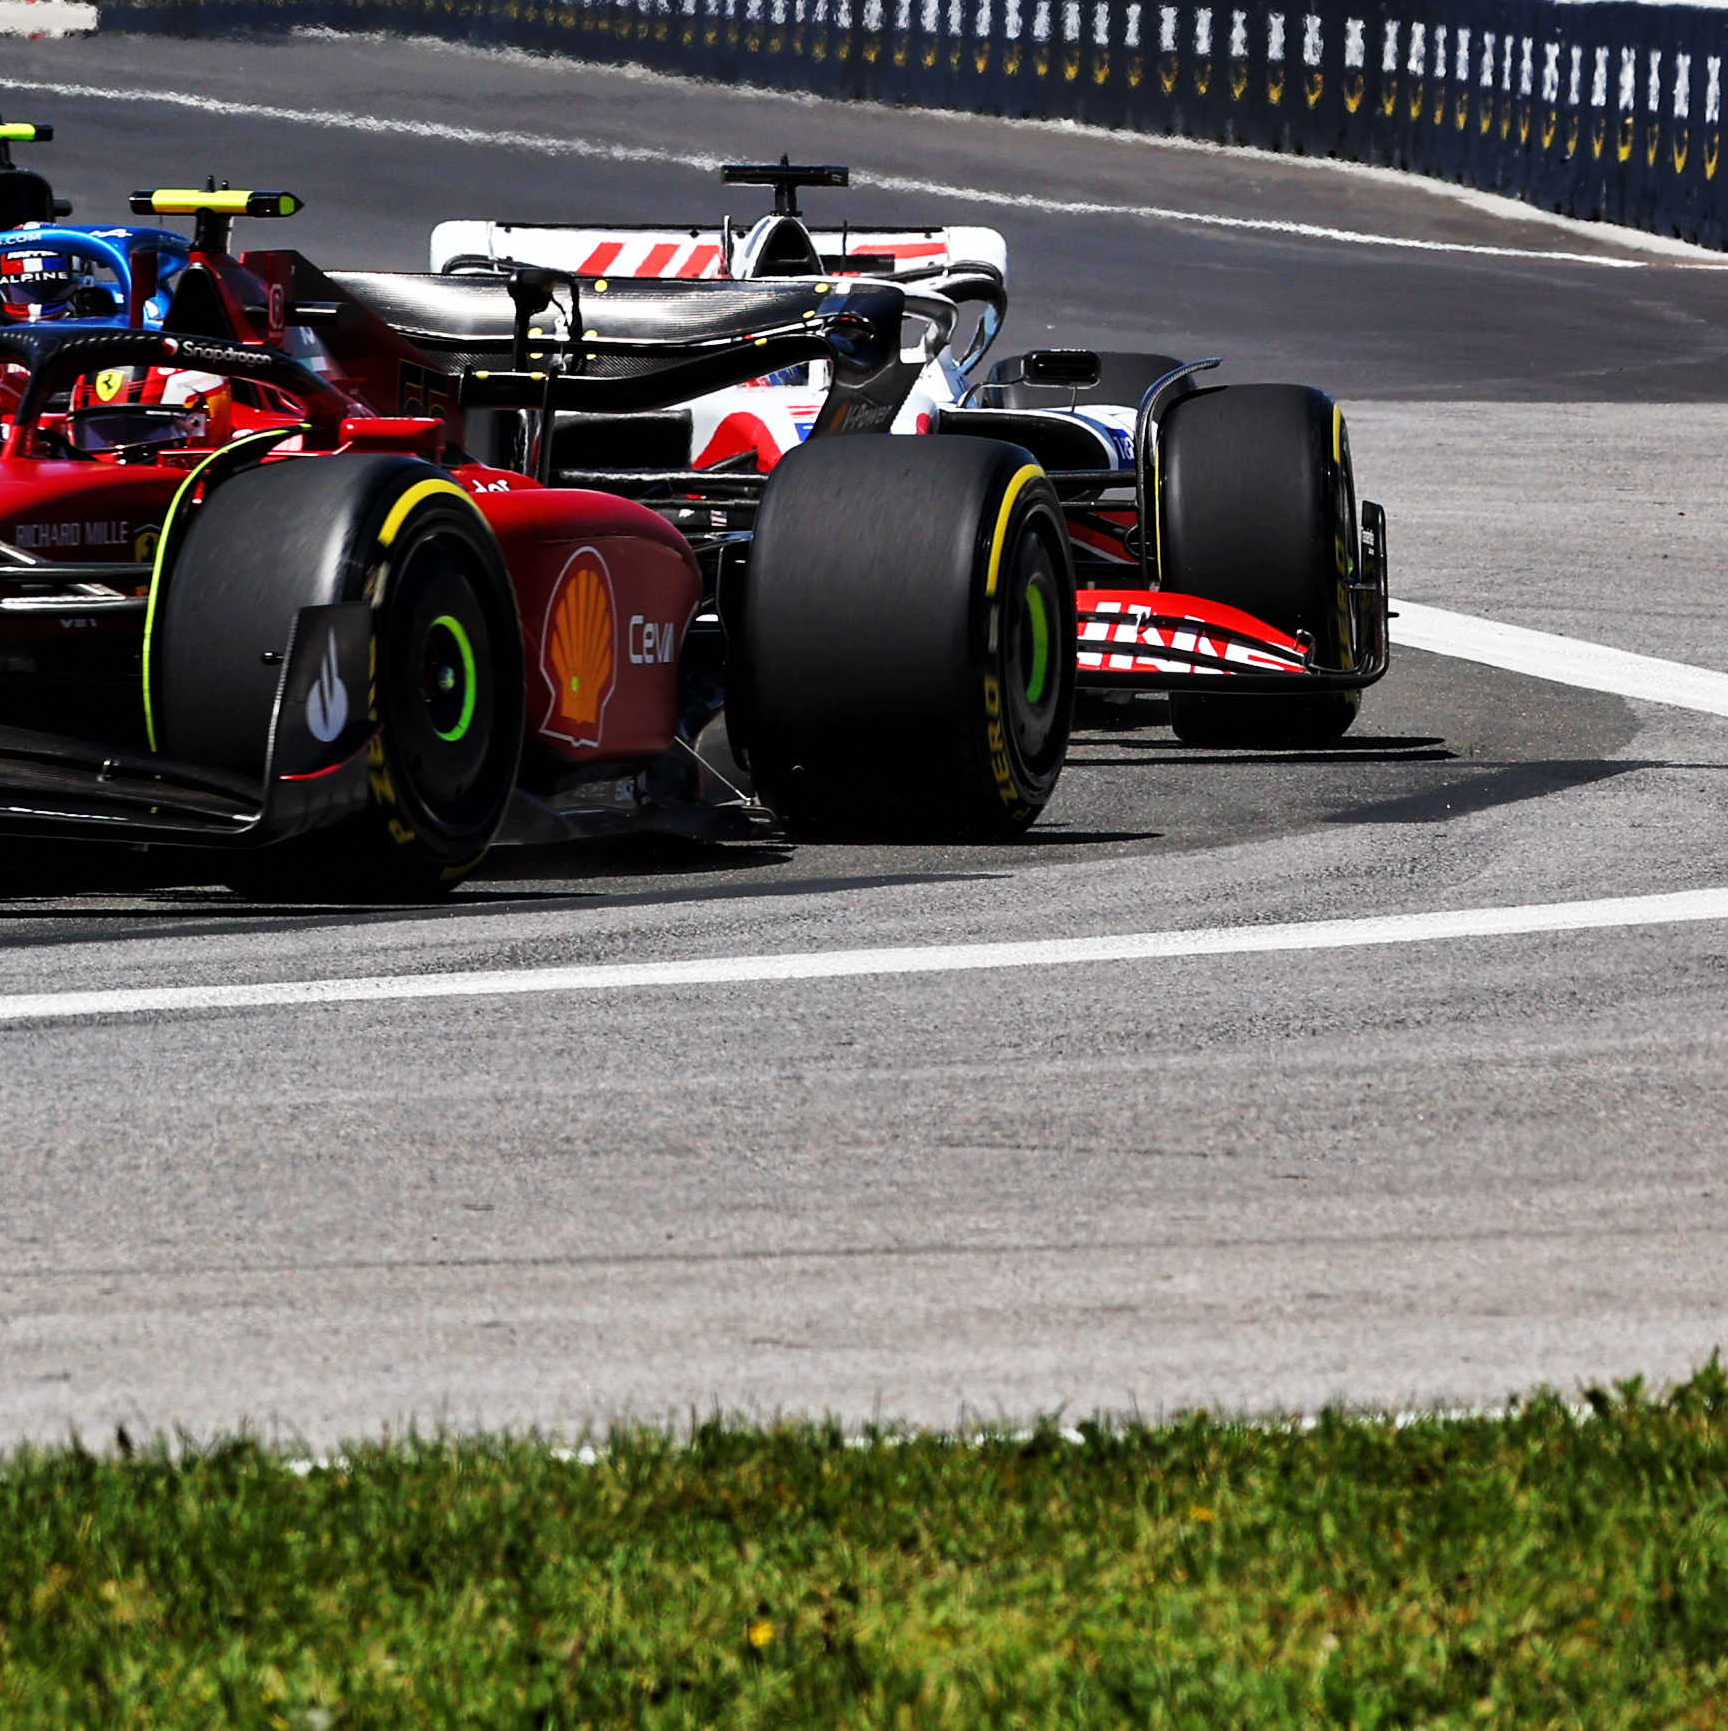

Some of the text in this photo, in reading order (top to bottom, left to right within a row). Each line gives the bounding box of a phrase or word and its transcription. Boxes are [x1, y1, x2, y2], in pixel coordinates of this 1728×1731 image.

[0, 271, 69, 285] ALPINE
[182, 340, 273, 368] Snapdragon
[14, 520, 130, 549] RICHARD MILLE
[983, 675, 1019, 808] ZERO
